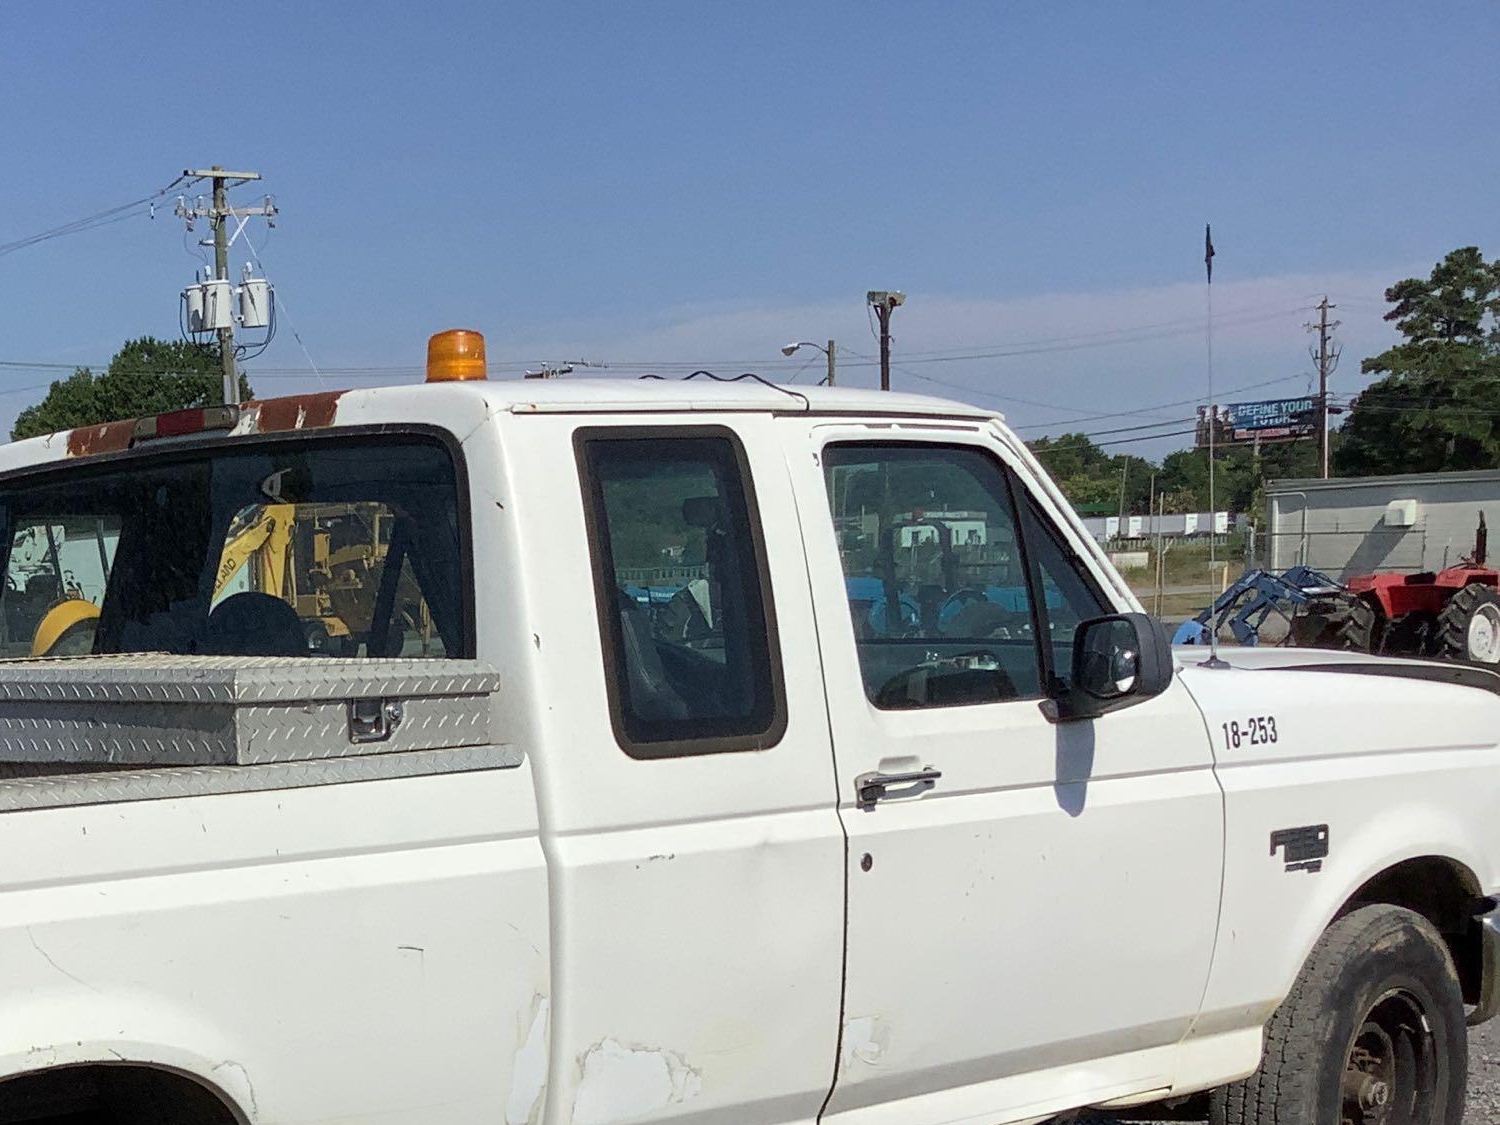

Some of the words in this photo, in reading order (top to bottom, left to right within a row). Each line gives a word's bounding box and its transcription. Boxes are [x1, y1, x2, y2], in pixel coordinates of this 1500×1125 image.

[1238, 405, 1278, 416] DEFINE
[1280, 400, 1312, 412] YOUR
[1222, 716, 1278, 750] 18-253
